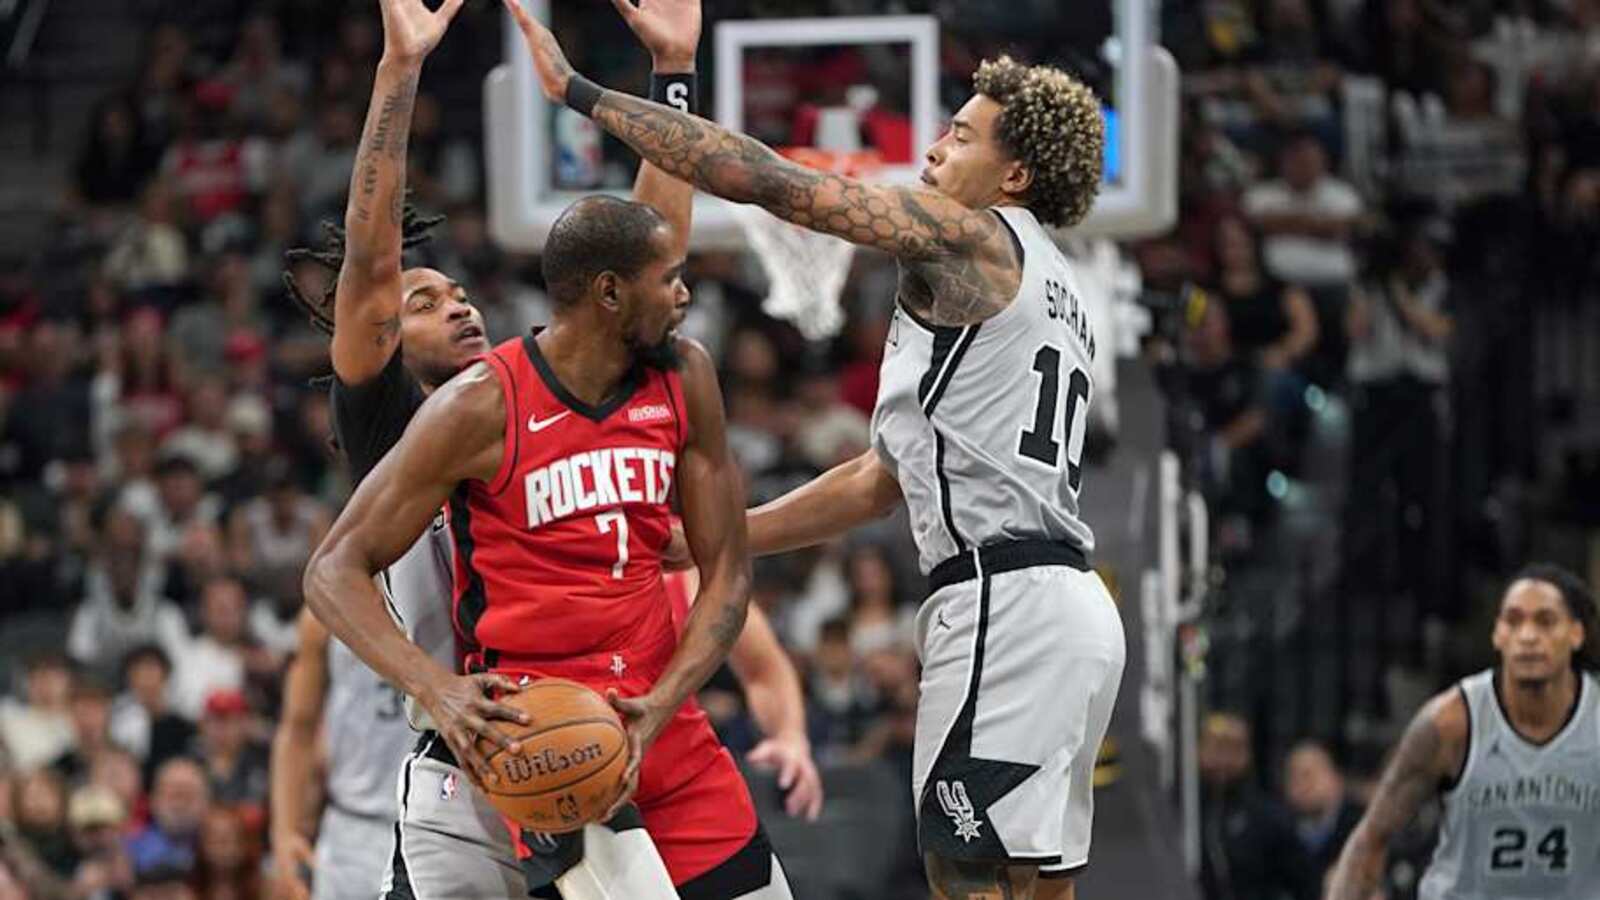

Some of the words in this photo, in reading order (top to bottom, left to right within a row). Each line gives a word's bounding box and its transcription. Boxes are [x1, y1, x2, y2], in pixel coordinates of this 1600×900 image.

[666, 82, 689, 113] S
[1017, 342, 1090, 496] 10
[525, 447, 675, 530] ROCKETS
[595, 510, 629, 579] 7
[505, 744, 602, 783] Wilson
[1490, 825, 1568, 870] 24
